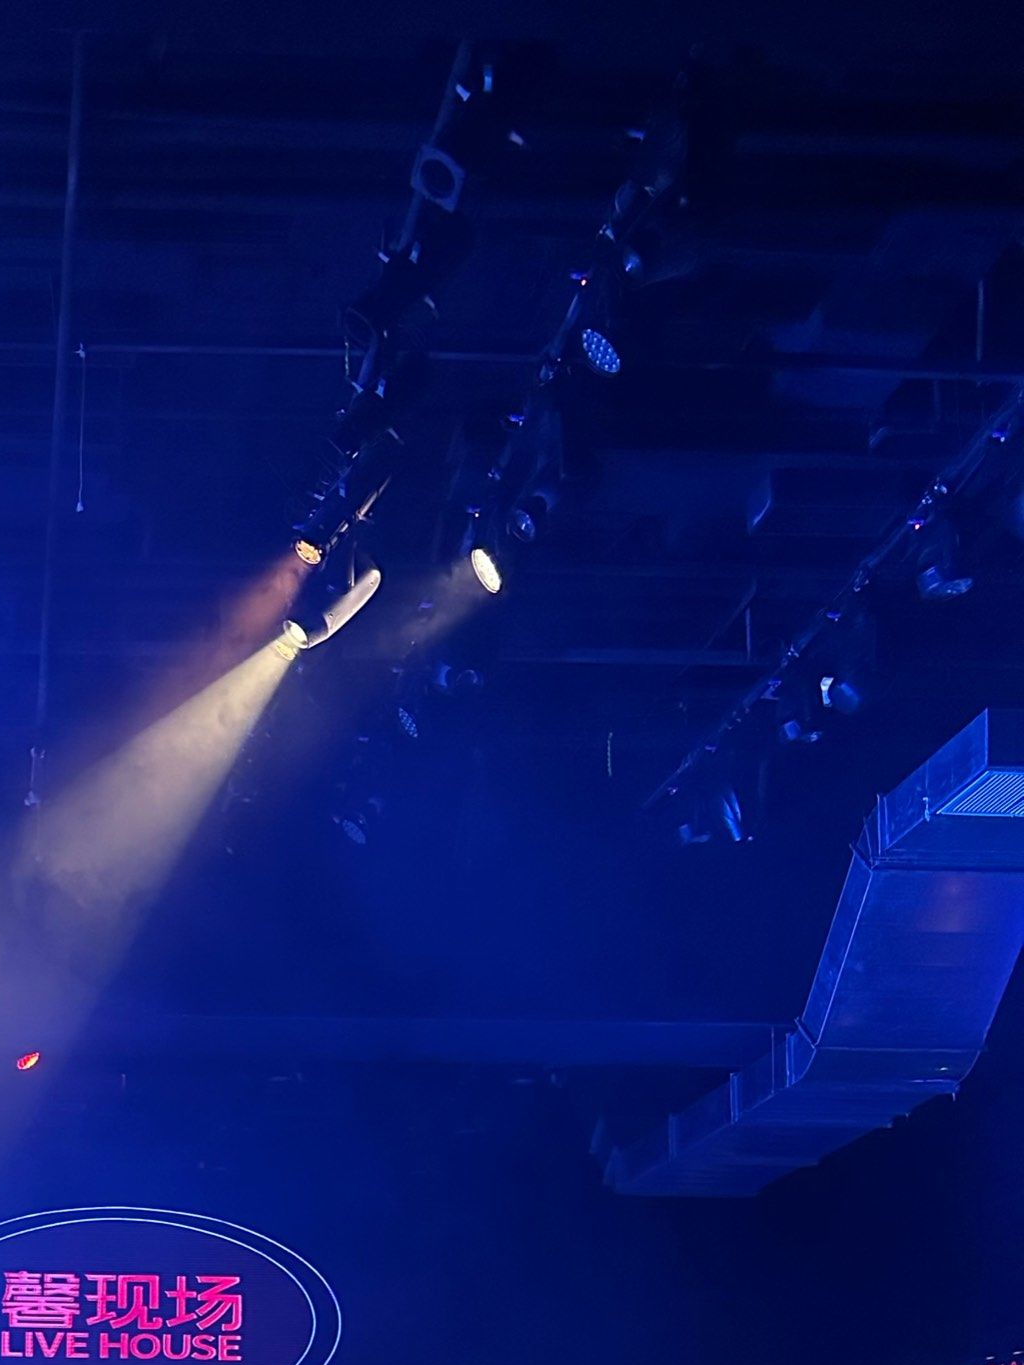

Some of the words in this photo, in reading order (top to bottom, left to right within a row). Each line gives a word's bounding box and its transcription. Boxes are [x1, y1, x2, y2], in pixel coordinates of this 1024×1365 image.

[2, 1270, 243, 1332] 馨现场
[1, 1331, 90, 1358] LIVE
[99, 1333, 242, 1361] HOUSE
